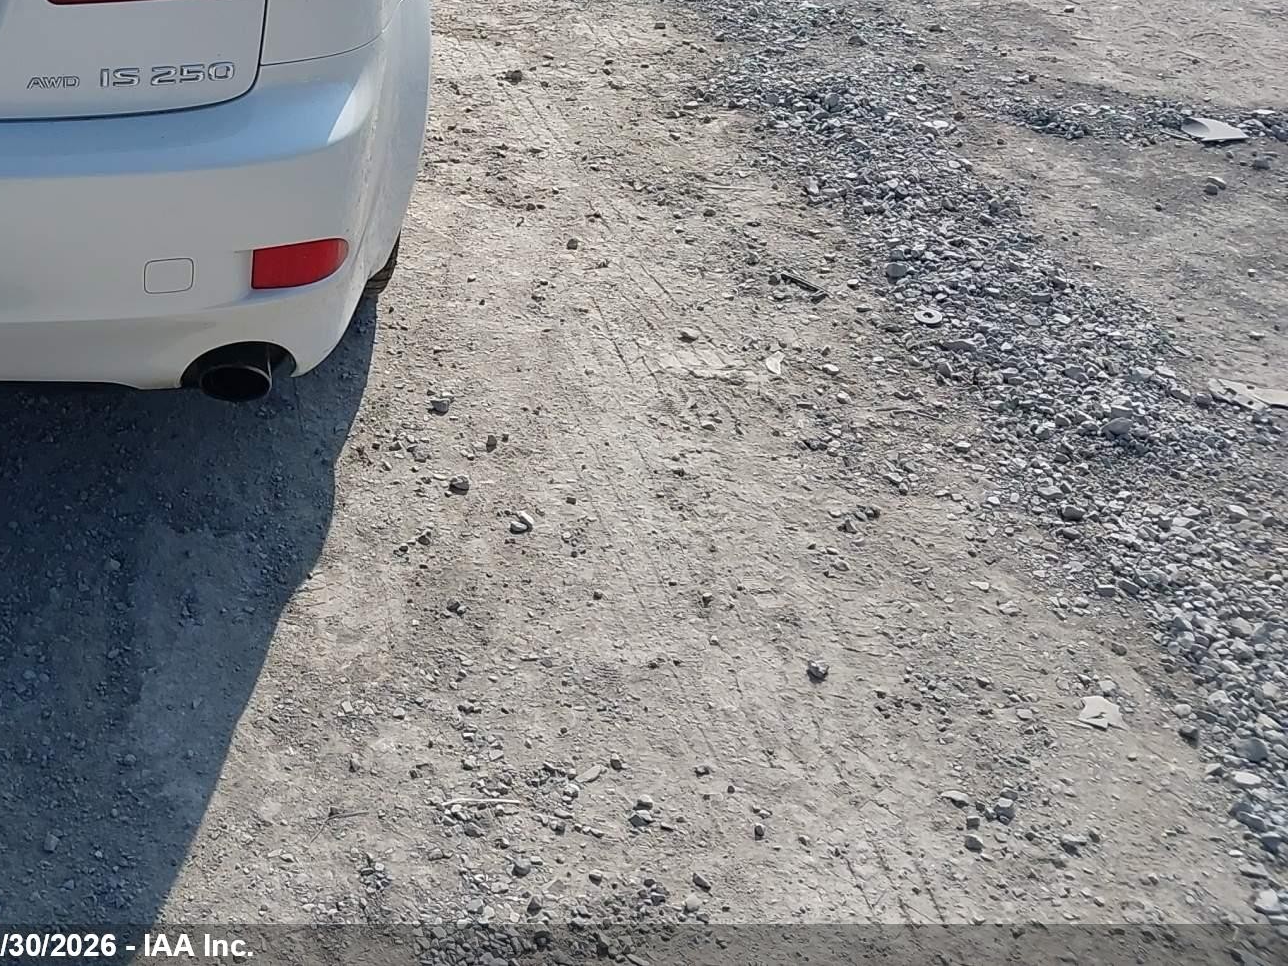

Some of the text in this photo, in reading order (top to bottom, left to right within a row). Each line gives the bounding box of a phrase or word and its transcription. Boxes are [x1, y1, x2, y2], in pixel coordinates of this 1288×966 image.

[26, 61, 235, 90] AWD IS 250
